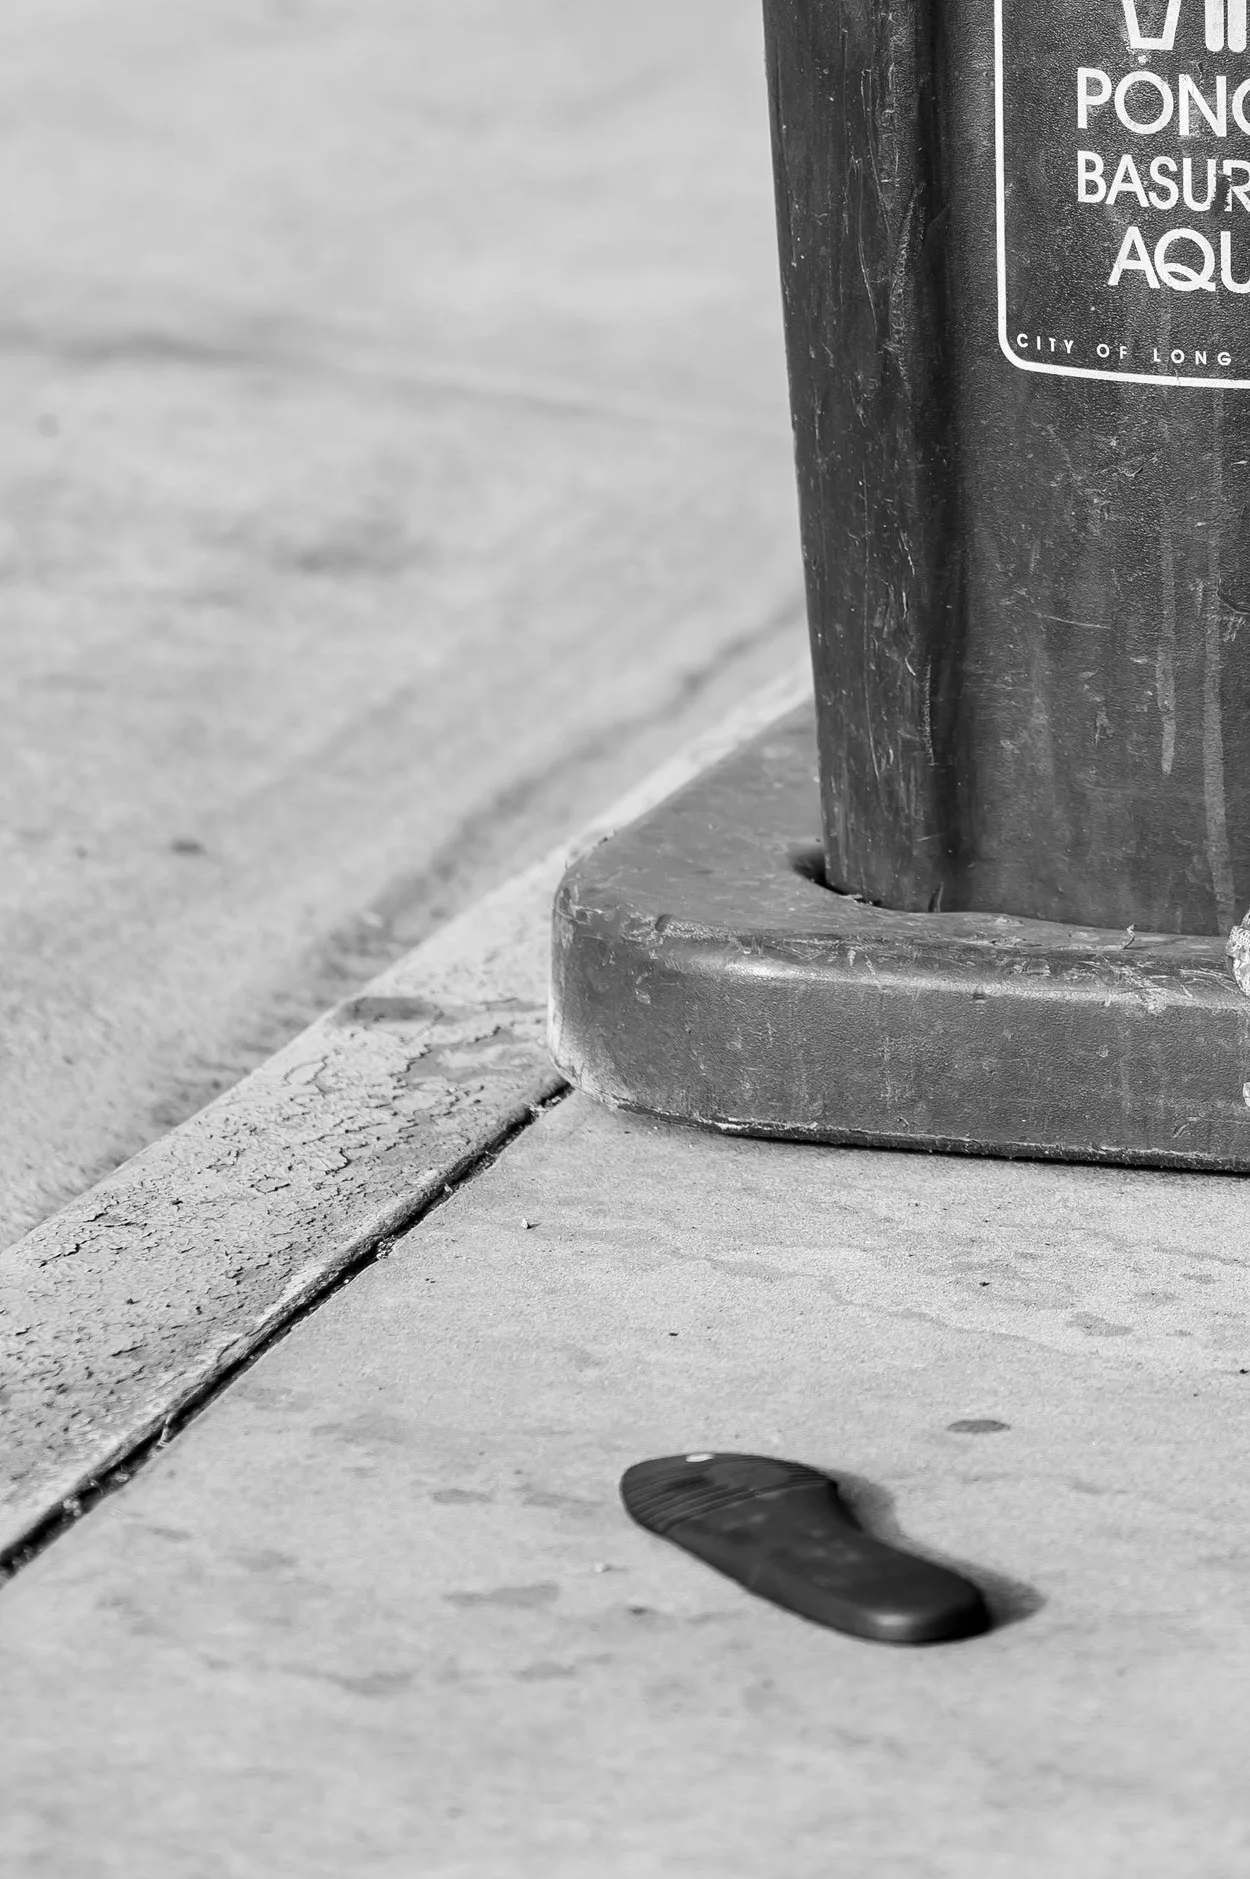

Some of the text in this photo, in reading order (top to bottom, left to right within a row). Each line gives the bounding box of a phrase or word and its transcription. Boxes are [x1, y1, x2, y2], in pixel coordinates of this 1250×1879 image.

[1016, 333, 1074, 354] CITY
[1096, 343, 1127, 360] OF
[1152, 348, 1232, 366] LONG
